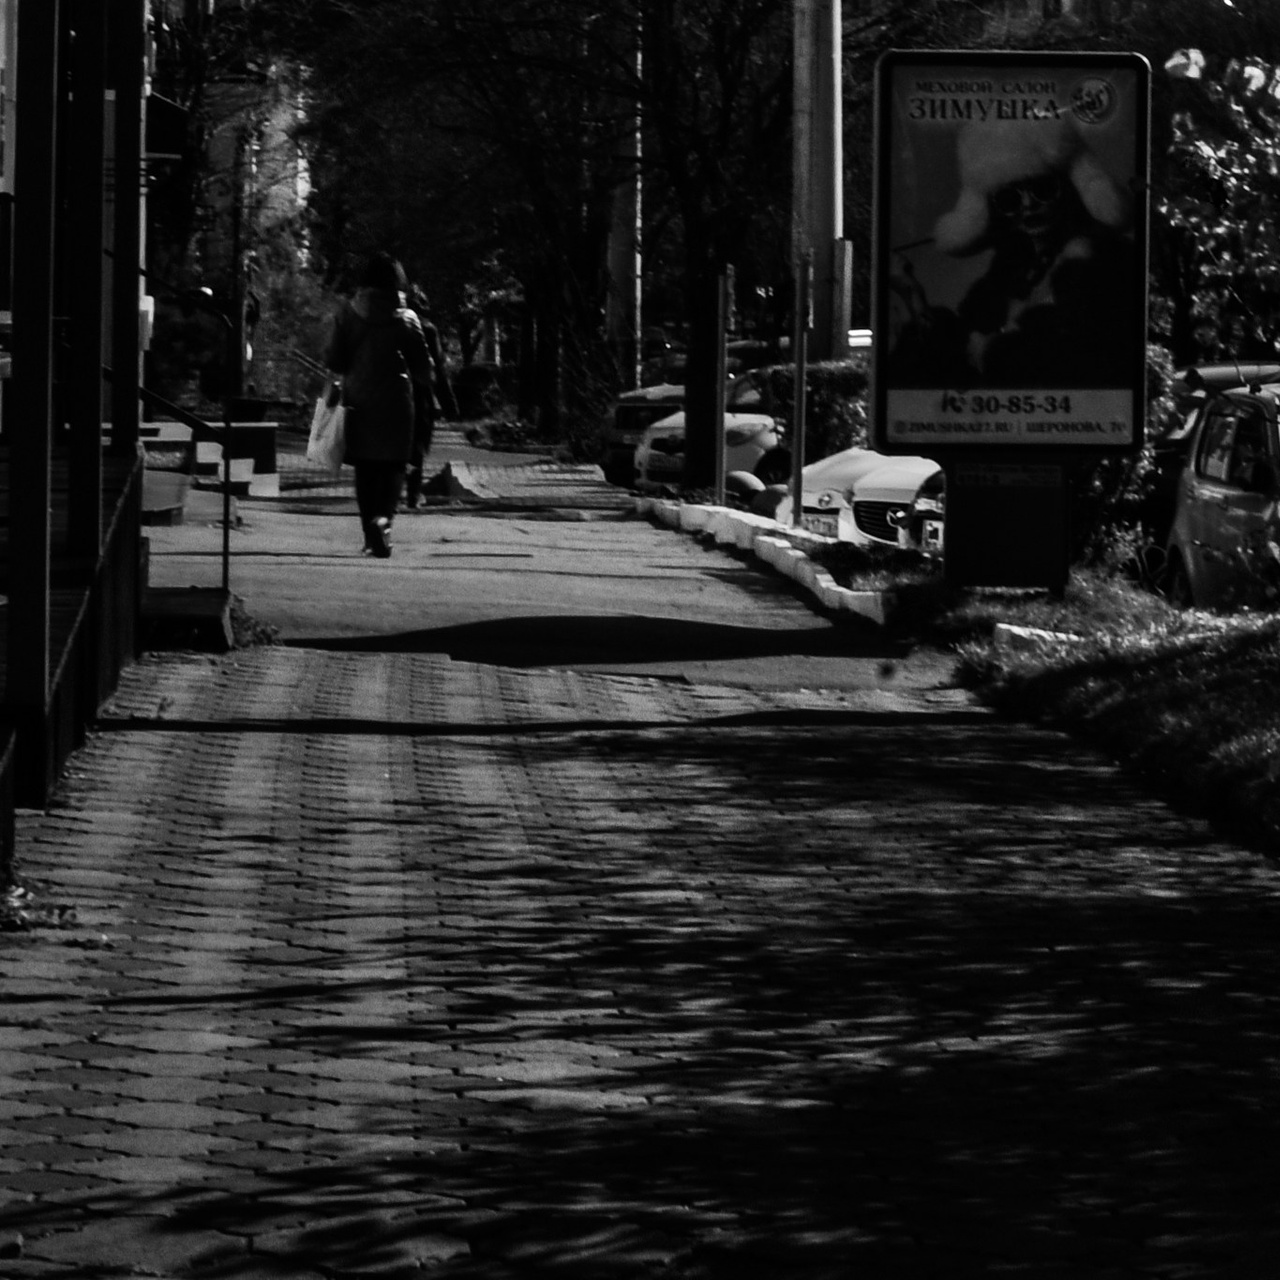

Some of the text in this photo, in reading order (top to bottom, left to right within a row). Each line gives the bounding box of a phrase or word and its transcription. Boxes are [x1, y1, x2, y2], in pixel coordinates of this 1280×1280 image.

[915, 81, 1057, 94] МЕХОВОЙ САЛОН
[909, 97, 1061, 121] ЗИМУШКА
[971, 396, 1072, 414] 30-85-34
